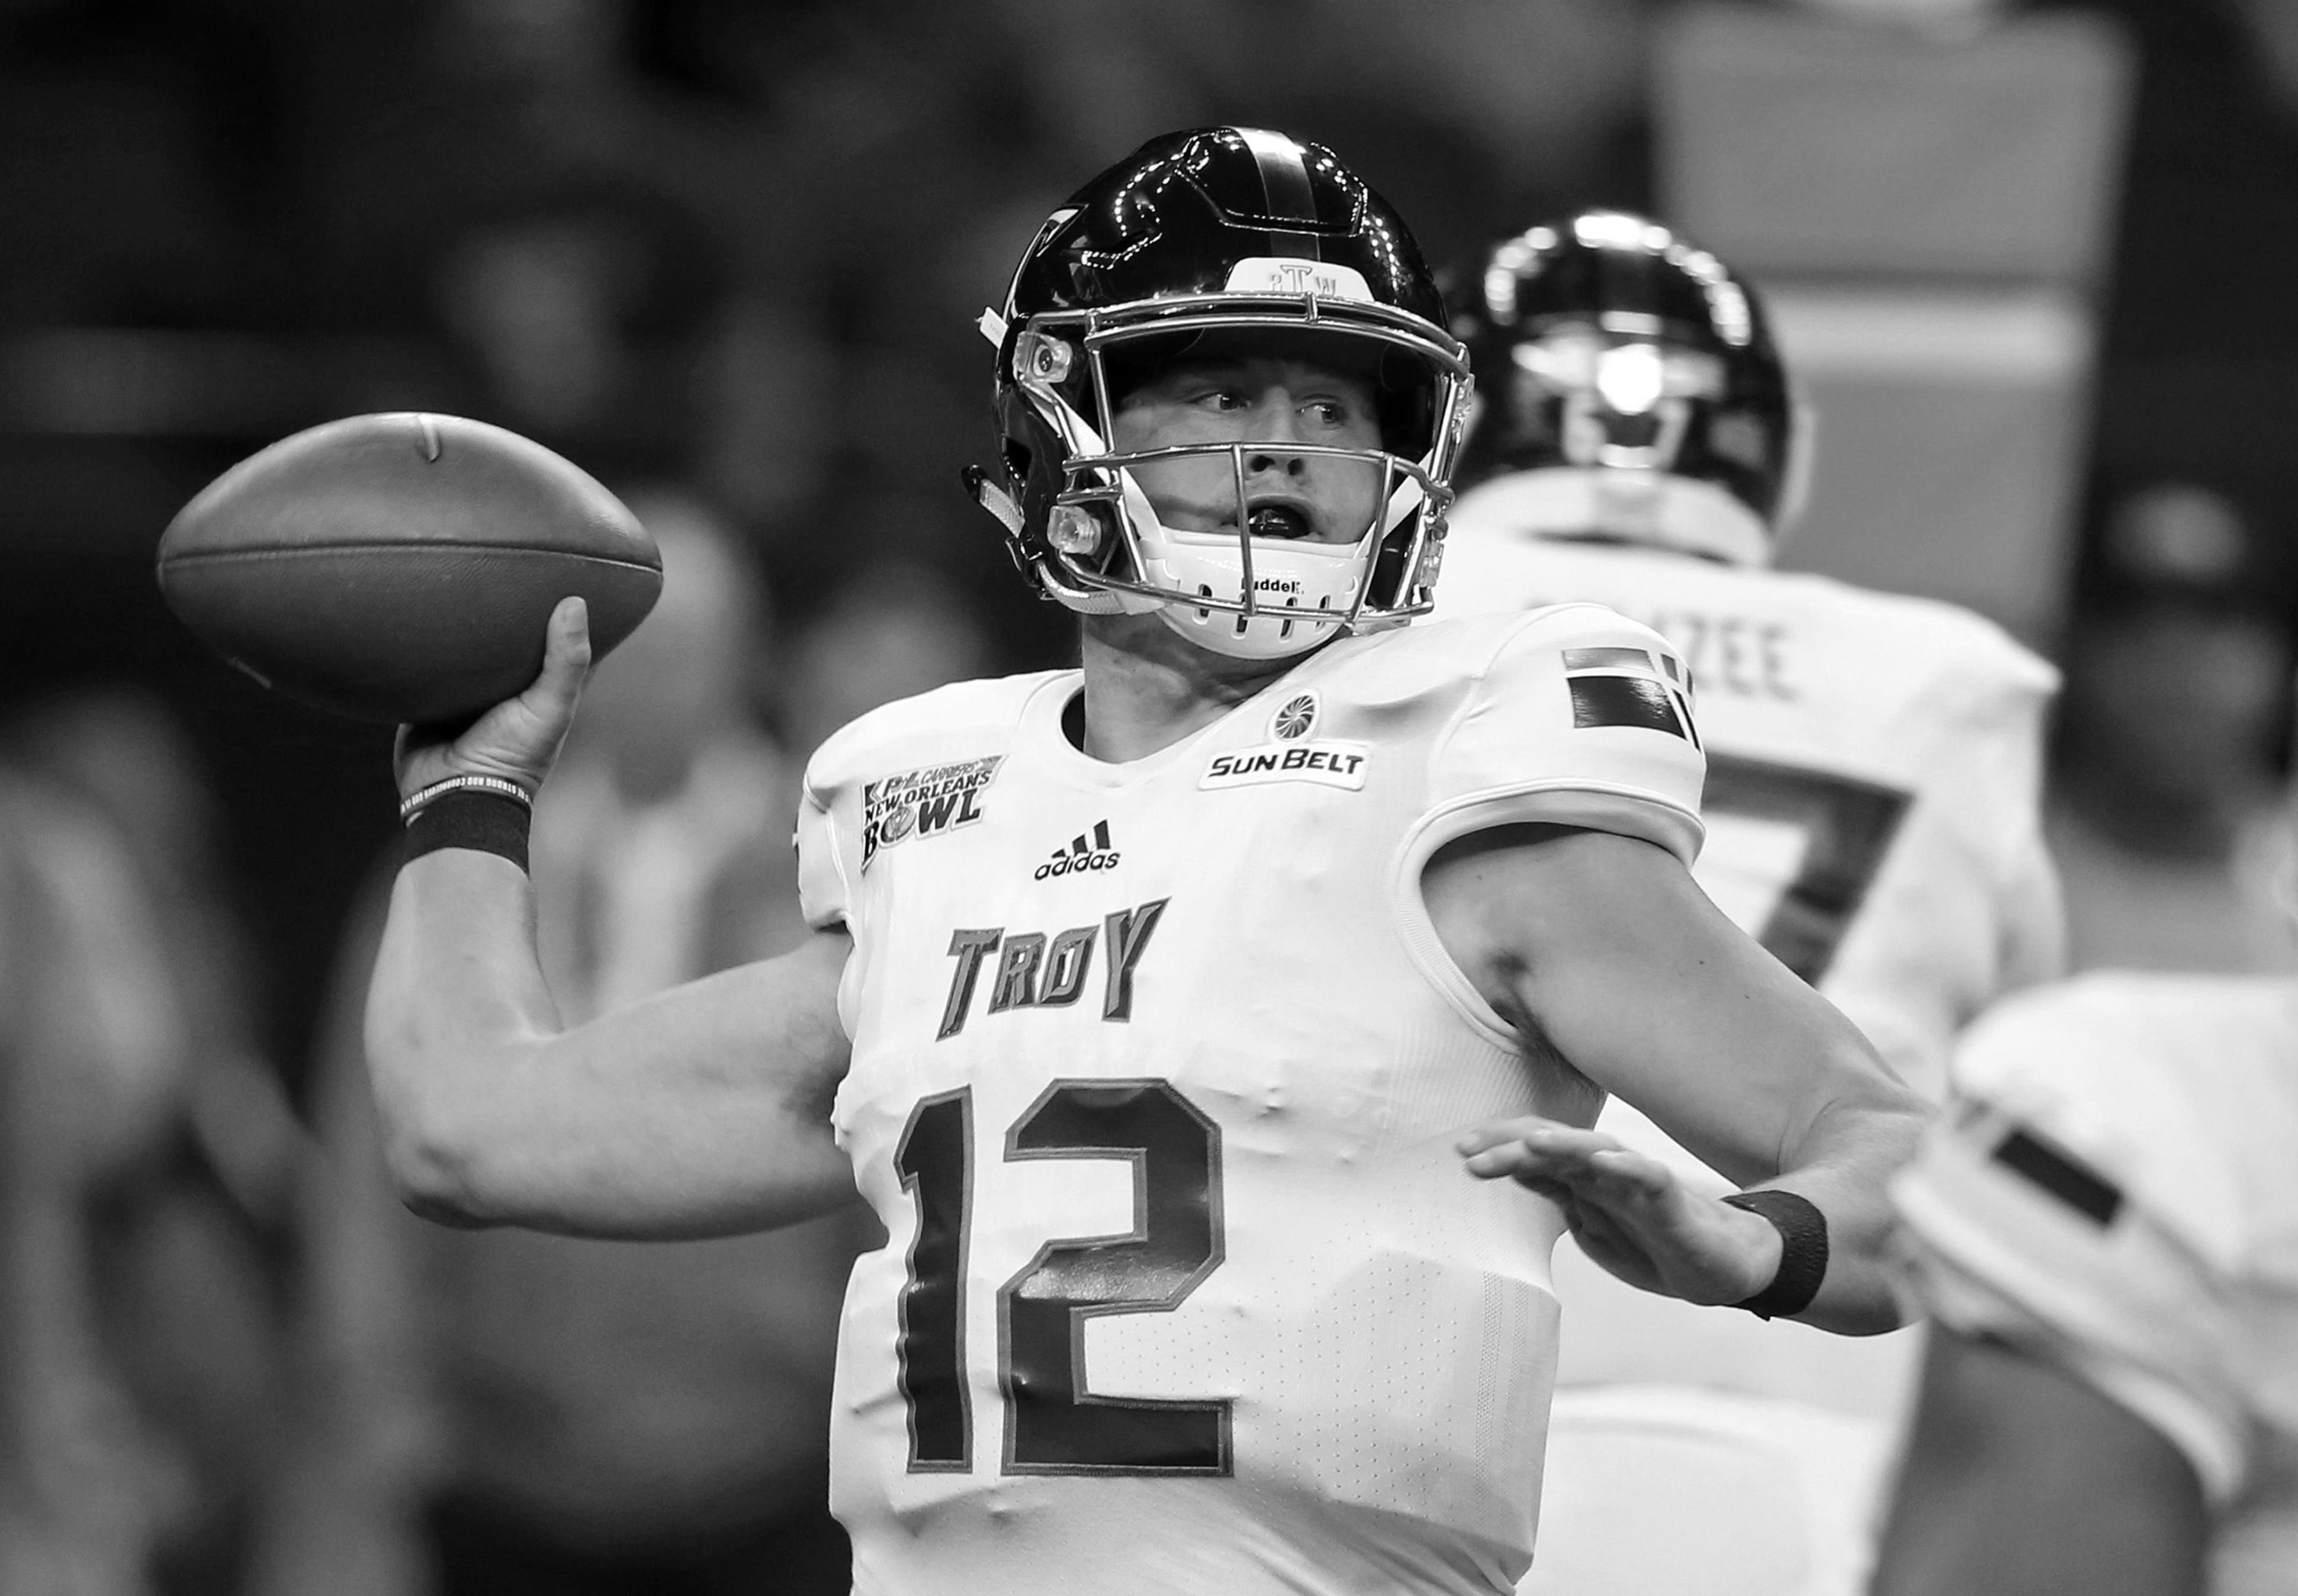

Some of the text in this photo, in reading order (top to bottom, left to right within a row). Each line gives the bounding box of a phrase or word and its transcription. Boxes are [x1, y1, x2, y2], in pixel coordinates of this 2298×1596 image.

[1241, 578, 1301, 594] iddel
[862, 787, 982, 867] BOWL
[865, 770, 994, 827] NEW ORLEANS
[1034, 851, 1121, 881] adidas
[935, 895, 1174, 1043] TROY
[893, 1077, 1235, 1476] 12
